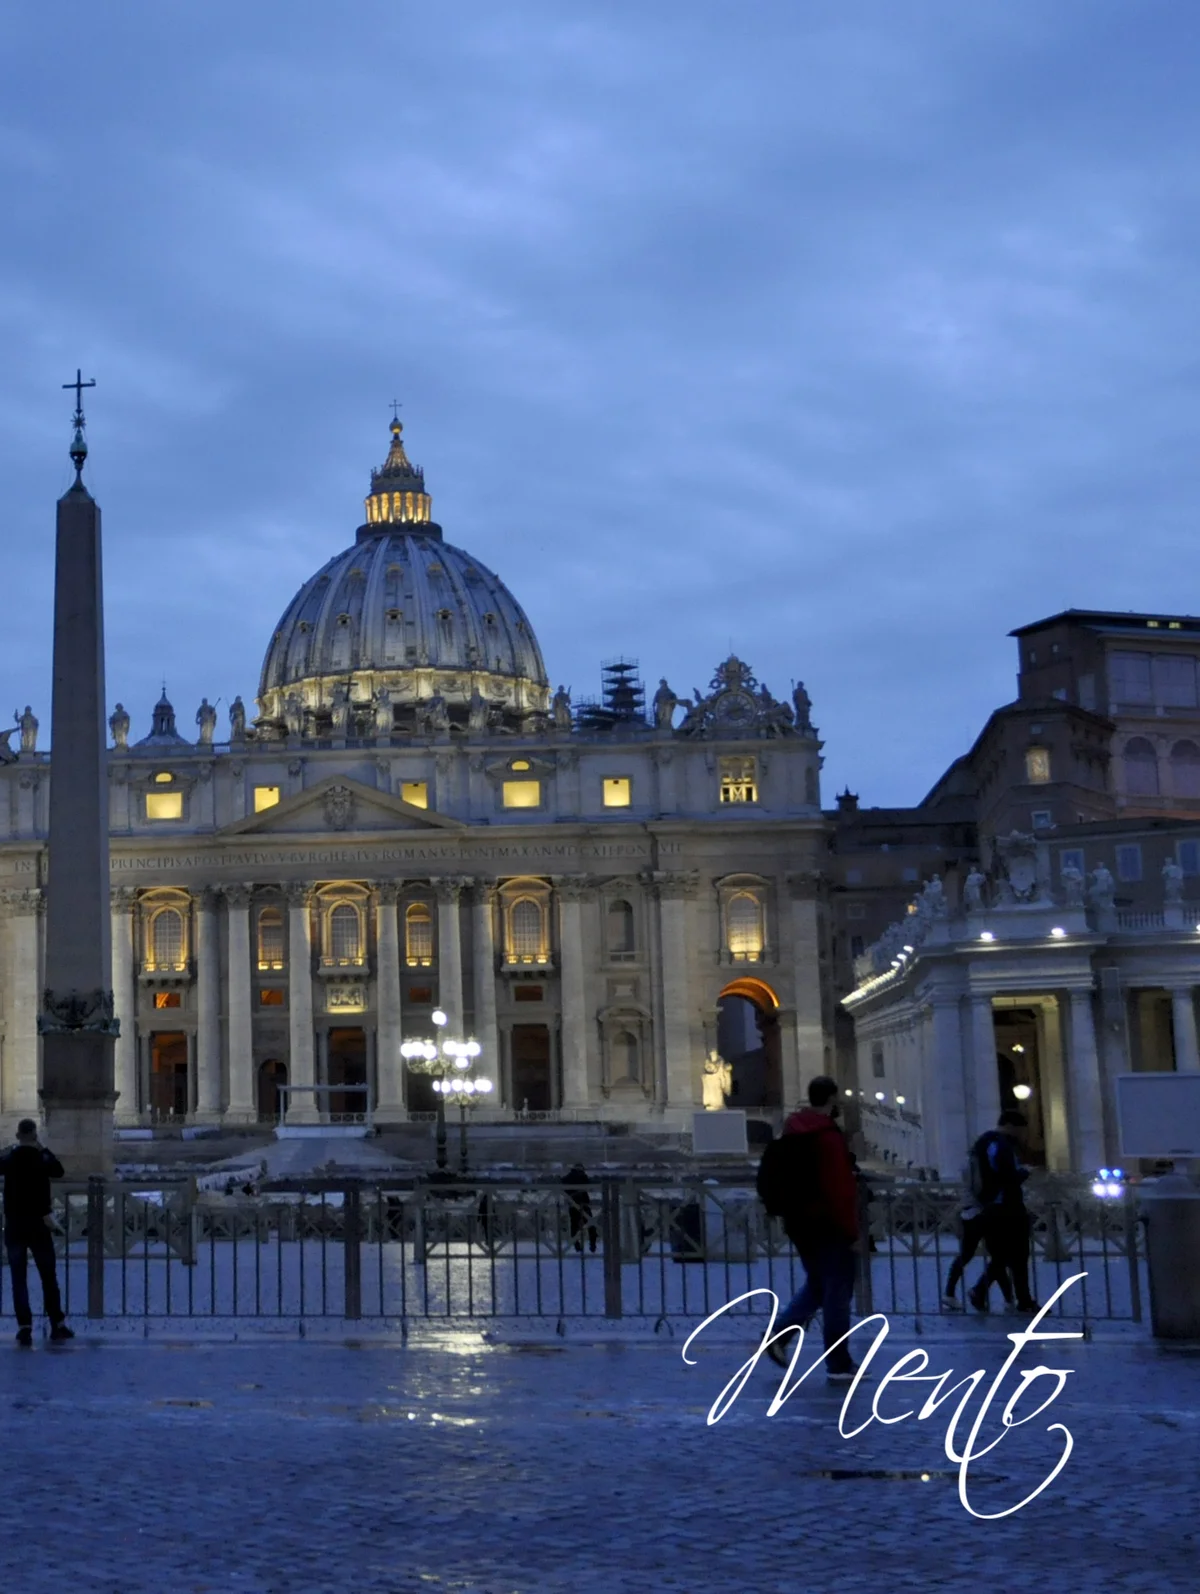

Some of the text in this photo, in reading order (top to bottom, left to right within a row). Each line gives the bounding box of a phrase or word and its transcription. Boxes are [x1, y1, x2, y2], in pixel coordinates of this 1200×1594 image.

[14, 860, 31, 872] IN
[111, 856, 182, 868] PRINCIPIS
[382, 847, 456, 860] ROMANVS
[460, 846, 496, 859] PONT
[498, 845, 529, 857] MAX
